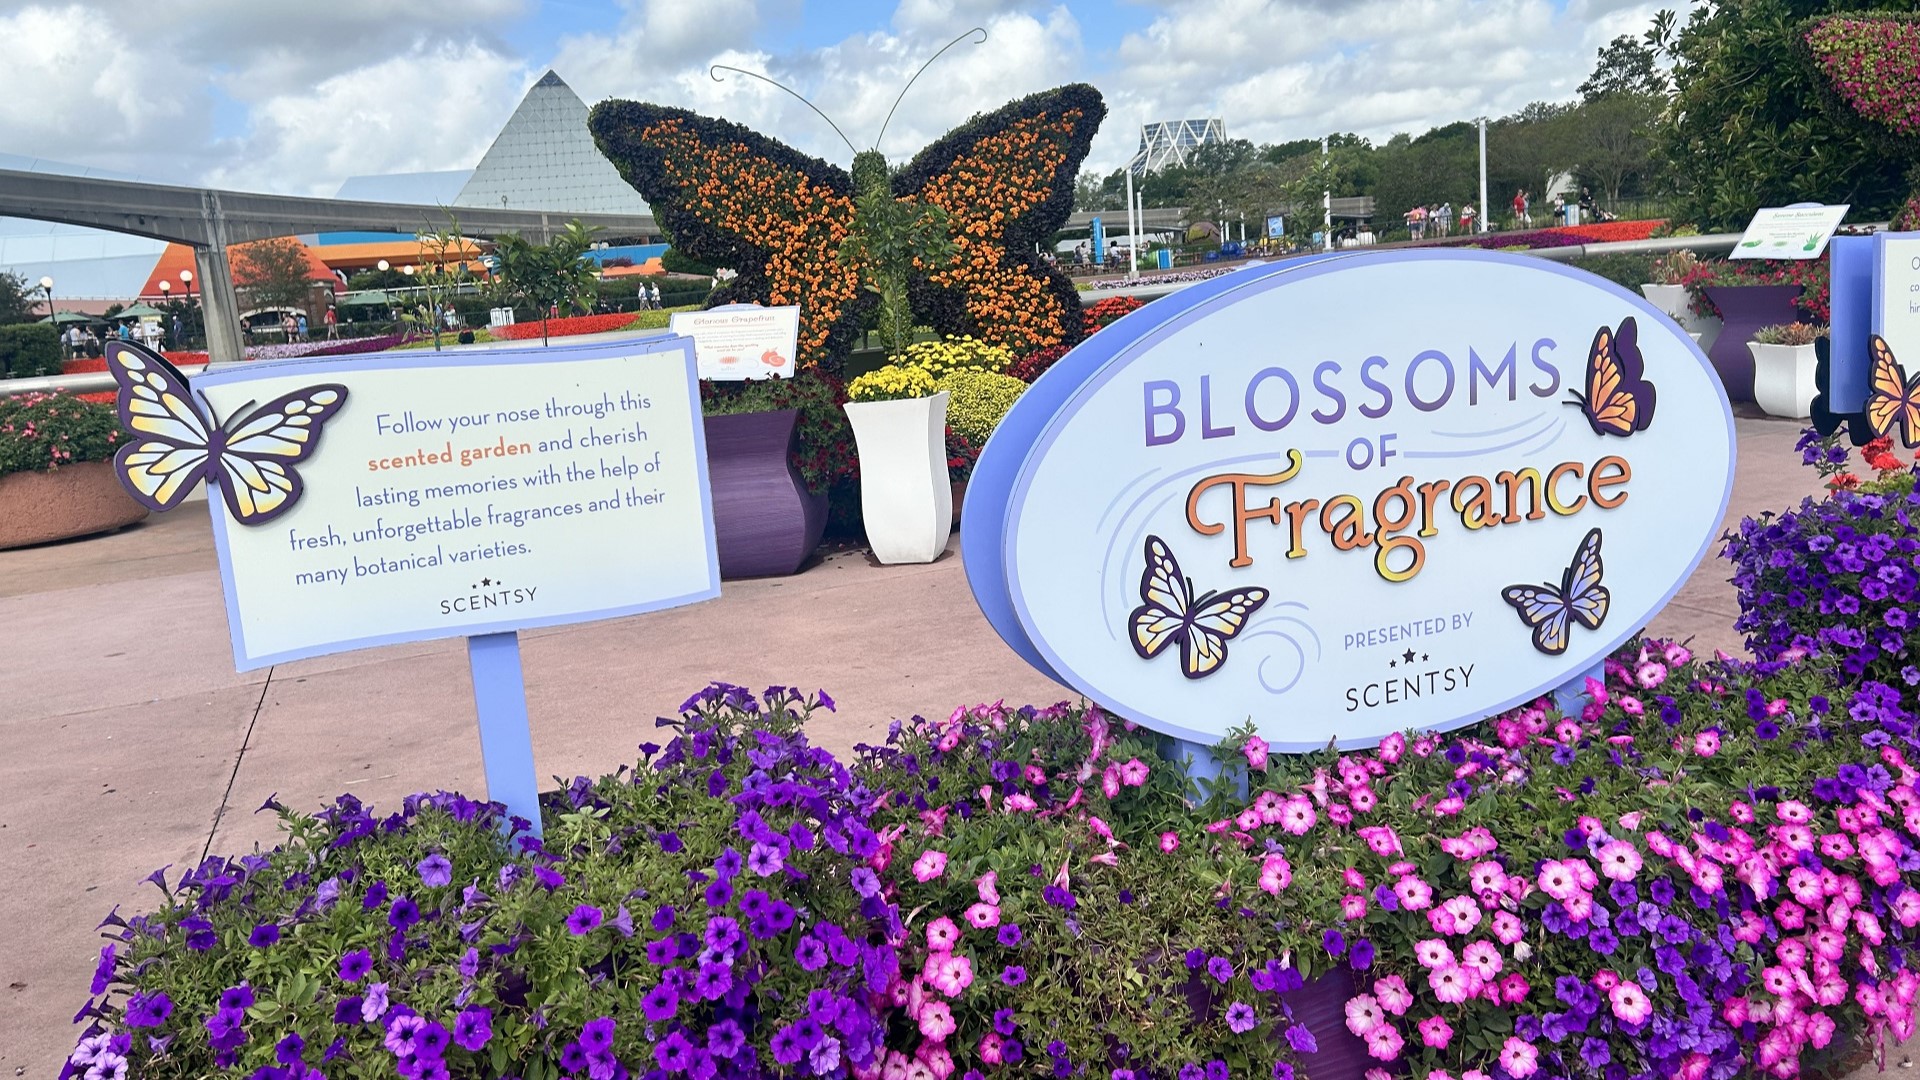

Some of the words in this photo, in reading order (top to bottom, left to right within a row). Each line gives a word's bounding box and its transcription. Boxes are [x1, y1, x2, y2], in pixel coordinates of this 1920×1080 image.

[1910, 284, 1920, 293] co
[731, 315, 775, 324] Grapefruit
[377, 411, 442, 435] Follow
[449, 414, 490, 434] your
[497, 409, 540, 423] nose
[546, 392, 615, 419] through
[620, 390, 651, 411] this
[1144, 338, 1560, 447] BLOSSOMS
[369, 442, 452, 471] scented
[461, 436, 531, 467] garden
[539, 428, 572, 452] and
[580, 421, 647, 447] cherish
[1346, 433, 1397, 471] OF
[356, 486, 420, 507] lasting
[425, 475, 517, 499] memories
[523, 464, 561, 487] with
[566, 461, 595, 482] the
[600, 455, 638, 480] help
[644, 451, 660, 472] of
[290, 524, 346, 551] fresh,
[353, 508, 482, 542] unforgettable
[488, 503, 582, 527] fragrances
[589, 488, 620, 512] and
[626, 486, 665, 507] their
[1185, 448, 1631, 583] Fragrance
[296, 568, 348, 585] many
[354, 544, 442, 577] botanical
[449, 541, 531, 563] varieties.
[441, 584, 537, 614] SCENTSY
[1345, 618, 1445, 650] PRESENTED
[1453, 612, 1473, 630] BY
[1346, 664, 1474, 712] SCENTSY
